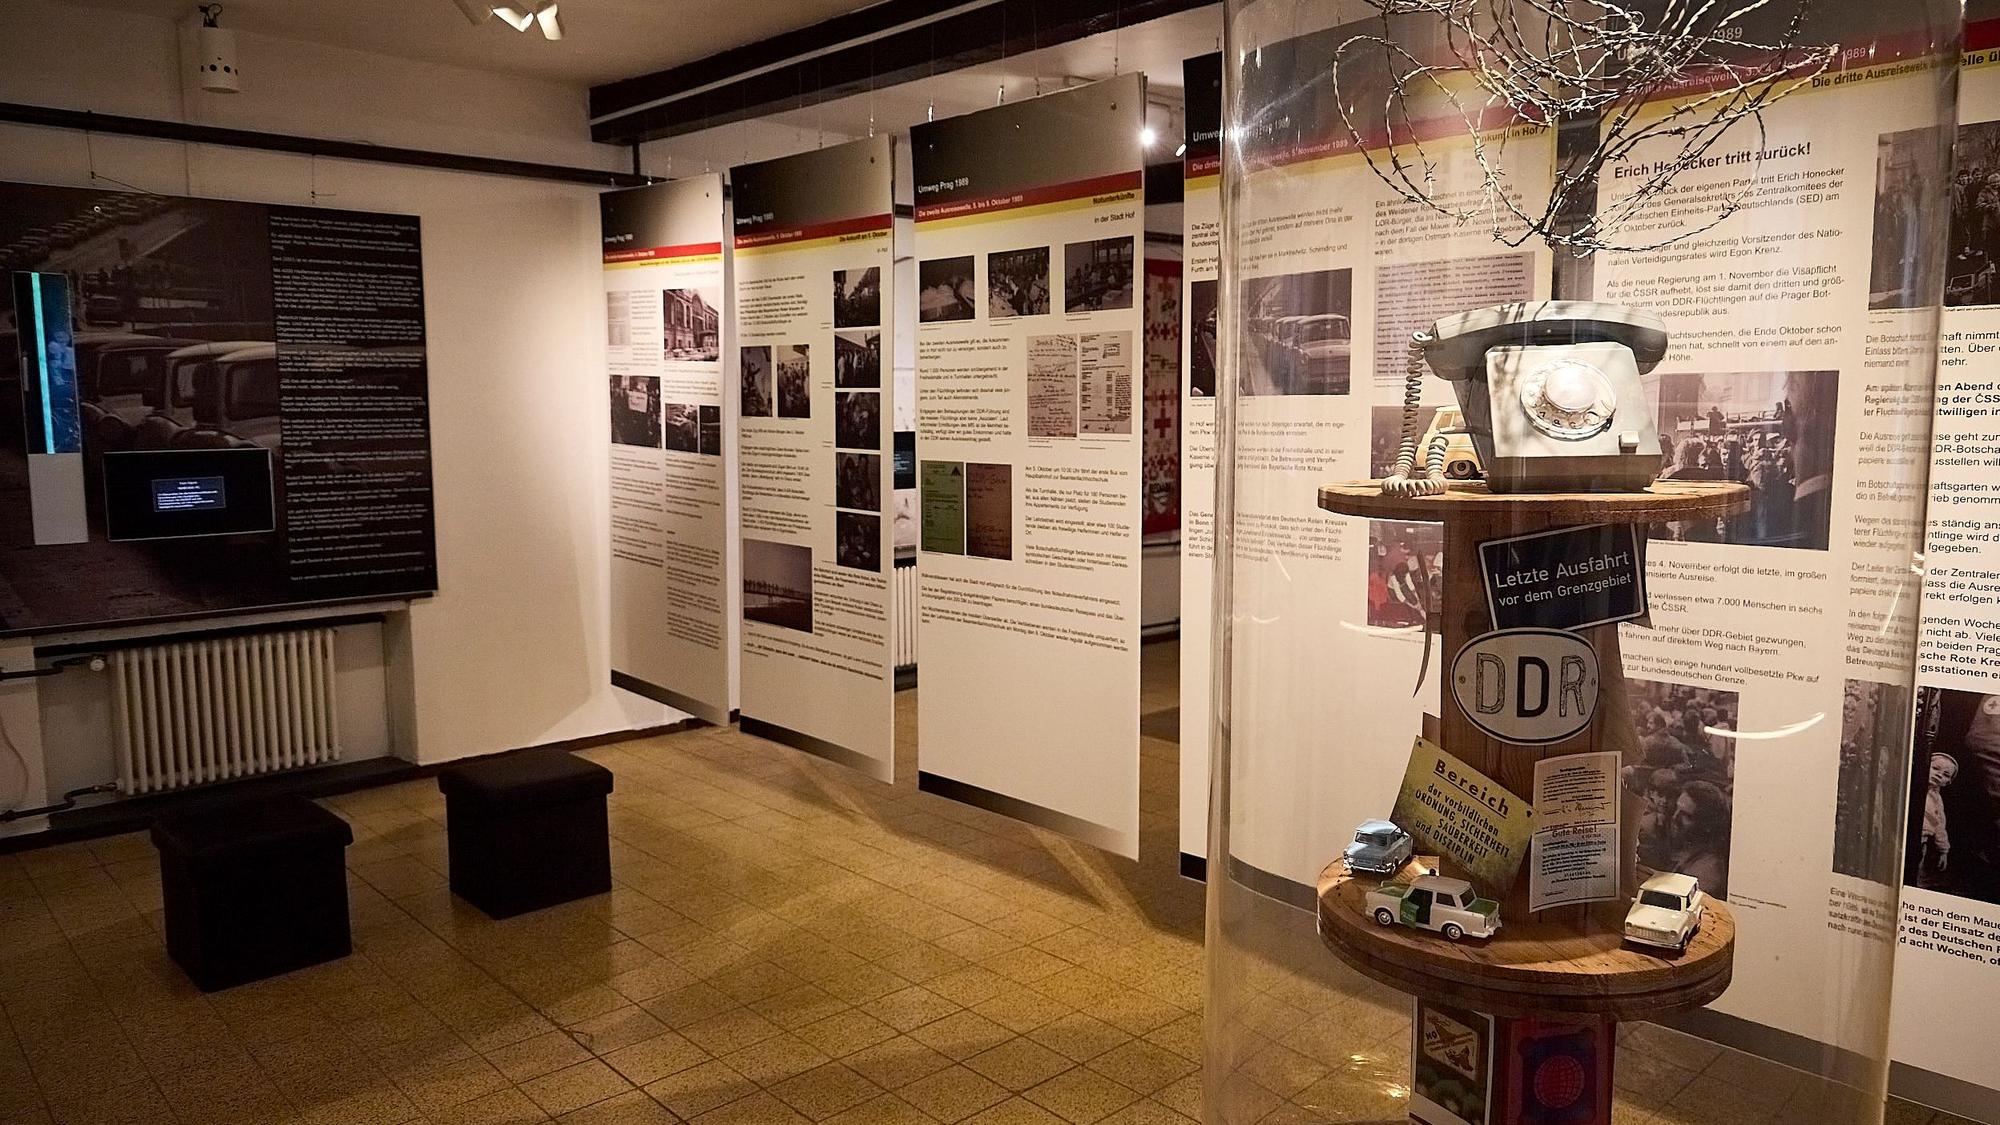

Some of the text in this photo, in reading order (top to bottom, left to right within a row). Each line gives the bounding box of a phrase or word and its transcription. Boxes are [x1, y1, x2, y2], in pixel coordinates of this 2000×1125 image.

[1841, 48, 1866, 61] 1989
[1812, 70, 1863, 87] Die dritte
[1192, 129, 1221, 143] Umwe
[1512, 125, 1538, 137] in Hof
[1614, 143, 1810, 178] Erich Honecker tritt zurück!
[1680, 166, 1844, 193] der eigenen tritt Erich Honecker
[1663, 190, 1736, 206] Generalsekretärs
[1756, 180, 1826, 196] Zentralkomitees
[1828, 179, 1843, 188] der
[1796, 193, 1822, 205] (SED)
[1624, 221, 1655, 231] Oktober
[1691, 236, 1738, 249] gleichzeitig
[1741, 231, 1798, 243] Vorsitzender
[1800, 230, 1814, 238] des
[1631, 250, 1707, 265] Verteidigungsrates
[1709, 249, 1726, 257] wird
[1730, 247, 1751, 258] Egon
[1657, 273, 1700, 285] Regierung
[1729, 269, 1773, 279] November
[1776, 268, 1789, 276] die
[1791, 265, 1836, 277] Visapflicht
[1713, 283, 1726, 291] sie
[1727, 282, 1750, 290] damit
[1753, 280, 1770, 289] den
[1772, 279, 1800, 288] dritten
[1802, 278, 1818, 286] und
[1672, 293, 1746, 306] DDR-Flüchtlingen
[1750, 292, 1763, 300] auf
[1764, 291, 1778, 300] die
[1781, 290, 1810, 301] Prager
[1738, 324, 1842, 336] die Ende Oktober schon
[1965, 331, 1999, 340] nimmt
[1707, 339, 1739, 347] schnellt
[1760, 338, 1787, 346] einem
[1805, 337, 1822, 345] den
[1968, 342, 1995, 352] Über
[1954, 382, 1992, 390] Abend
[1952, 395, 1971, 403] der
[1954, 432, 1978, 442] geht
[1941, 519, 1980, 530] ständig
[1966, 532, 1989, 540] wird
[1495, 551, 1629, 589] Letzte Ausfahrt
[1668, 560, 1710, 571] November
[1713, 564, 1739, 575] erfolgt
[1741, 566, 1754, 574] die
[1784, 569, 1794, 577] im
[1797, 569, 1826, 581] großen
[1930, 567, 1948, 575] der
[1499, 572, 1632, 607] vor dem Grenzgebiet
[1949, 580, 1966, 589] die
[1654, 591, 1822, 613] verlassen etwa 7.000 Menschen in sechs
[1948, 592, 1992, 605] erfolgen
[1625, 630, 1746, 651] fahren auf direktem Weg nach
[1658, 623, 1806, 648] mehr über DDR-Gebiet gezwungen,
[1926, 626, 1951, 636] nicht
[1954, 629, 1971, 638] ab.
[1936, 639, 1972, 651] beiden
[1622, 651, 1819, 682] machen sich einige hundert vollbesetzte Pkw auf
[1949, 653, 1976, 664] Rote
[1641, 664, 1712, 680] bundesdeutschen
[1476, 652, 1587, 718] DDR
[1435, 759, 1509, 815] Bereich
[1428, 783, 1499, 836] der vorbildlichen
[1416, 789, 1510, 858] ORDNUNG, SICHERHEIT
[1415, 820, 1475, 864] und DISZIPLIN
[1438, 819, 1489, 858] SAUBERKEIT
[1918, 903, 1970, 922] nach dem
[1904, 911, 1984, 938] ist der Einsatz
[1908, 924, 1992, 951] des Deutschen
[1909, 936, 1986, 963] acht Wochen,
